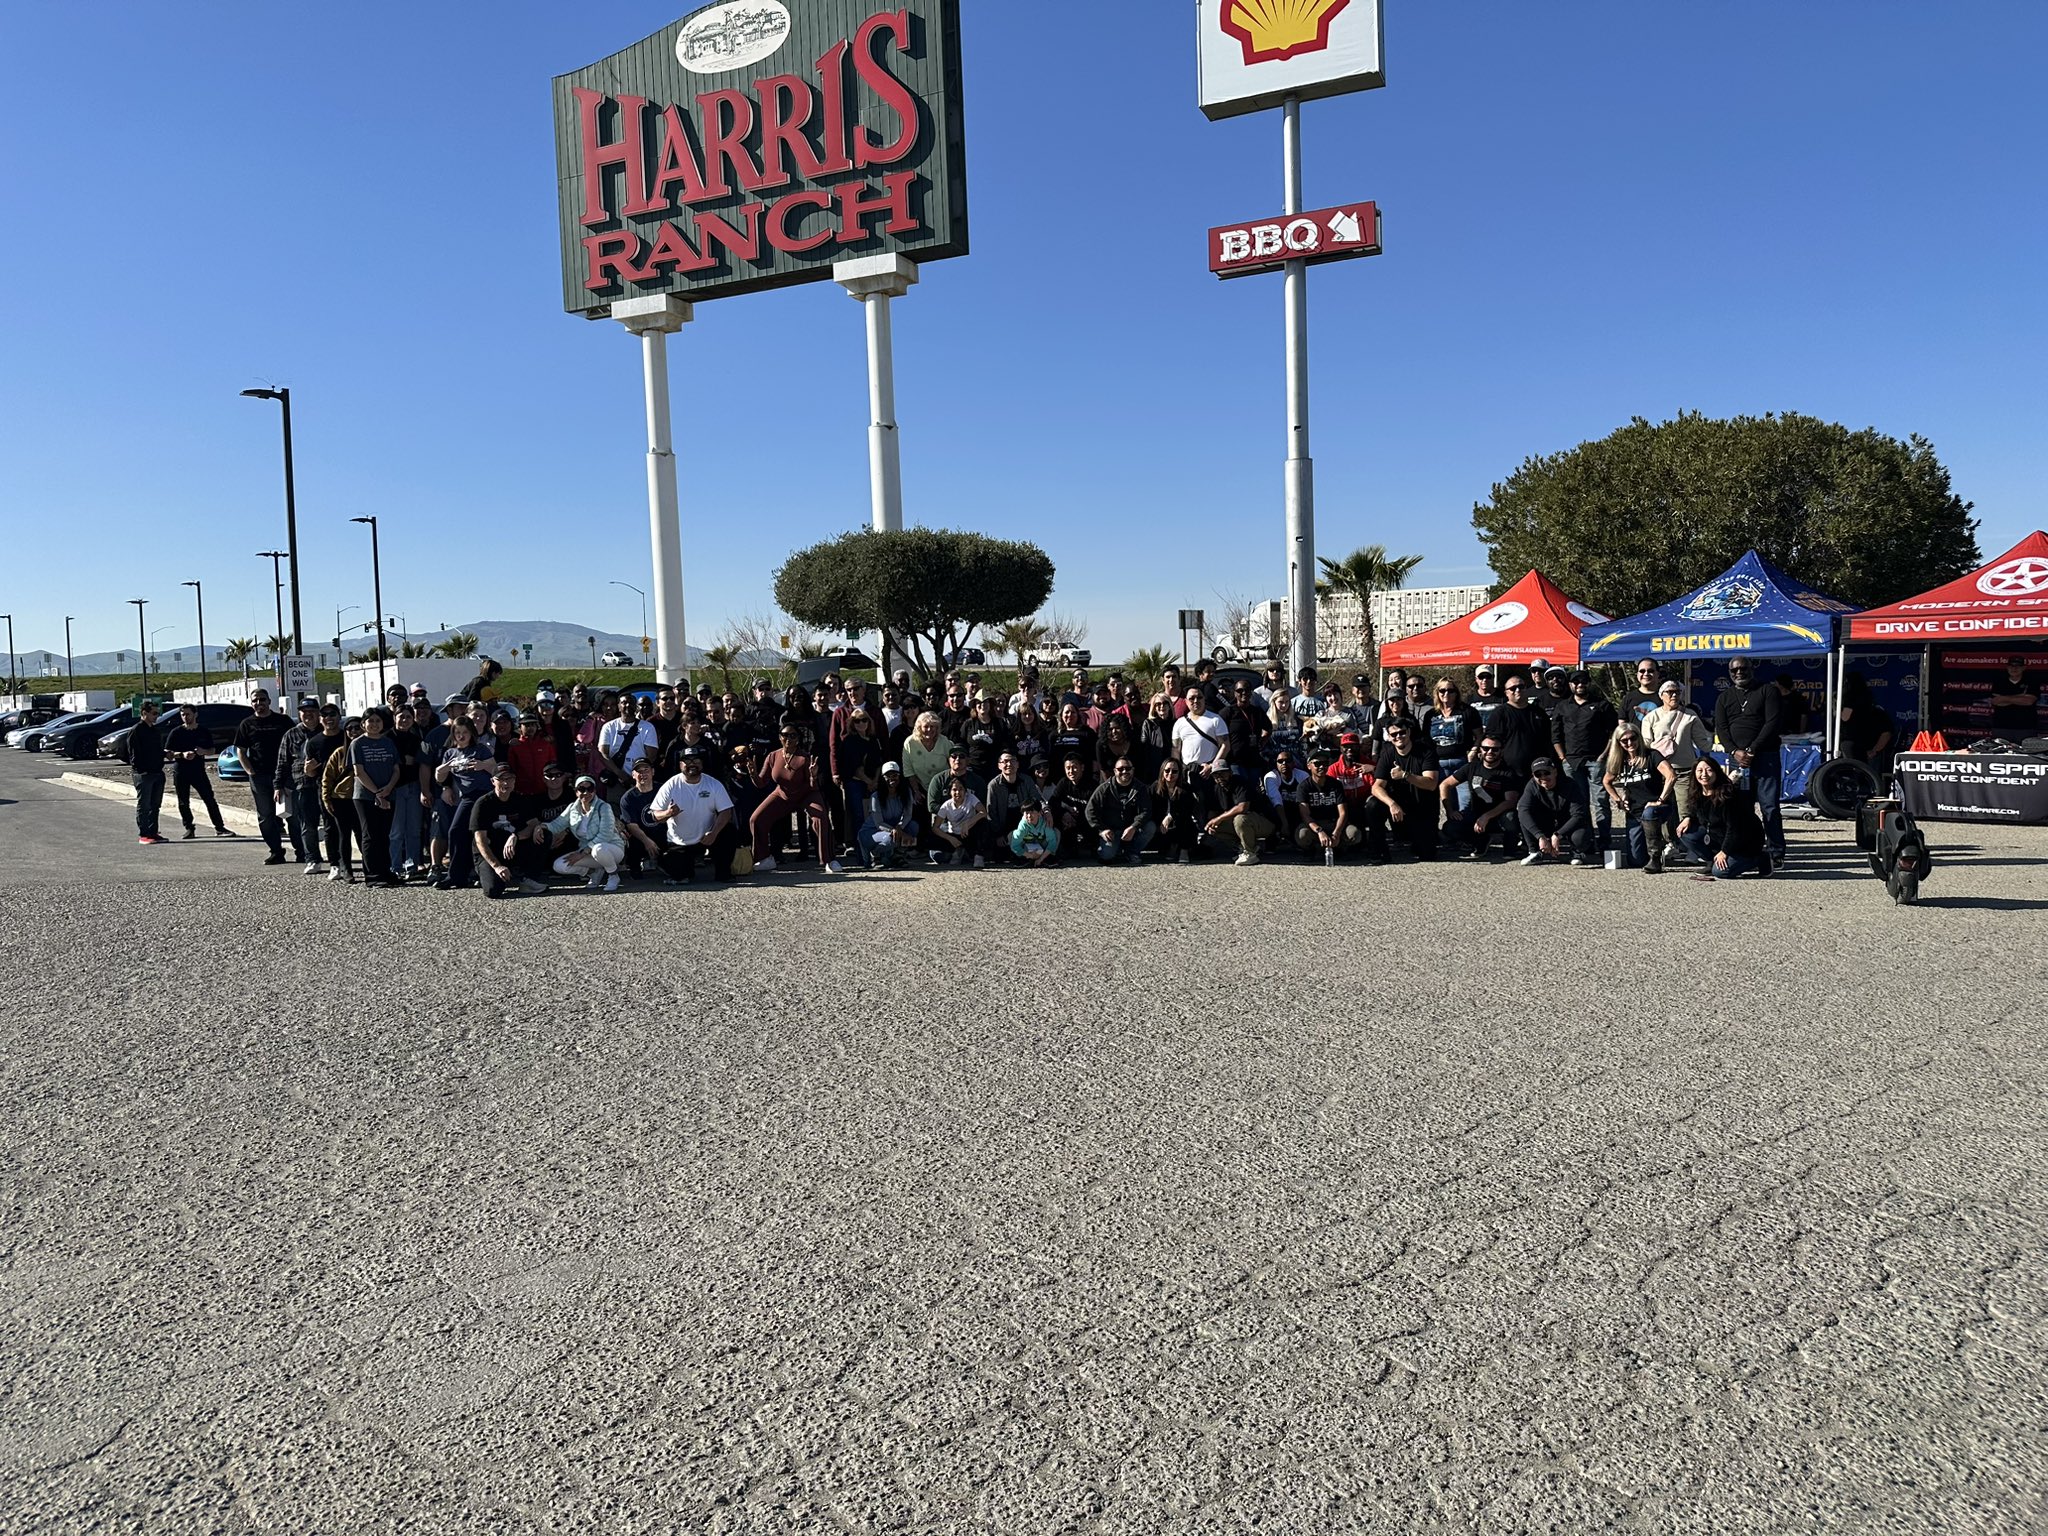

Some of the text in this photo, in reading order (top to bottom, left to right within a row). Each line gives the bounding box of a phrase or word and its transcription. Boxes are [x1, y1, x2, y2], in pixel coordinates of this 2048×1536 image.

[571, 8, 921, 227] HARRIS
[581, 169, 921, 290] RANCH
[1219, 217, 1322, 263] BBQ
[1898, 600, 2011, 611] MODERN
[1875, 621, 1940, 634] DRIVE
[1650, 633, 1751, 652] STOCKTON
[1490, 646, 1555, 654] FRESNOTESLAOWNERS
[288, 660, 312, 668] BEGIN
[291, 670, 309, 678] ONE
[291, 679, 309, 687] WAY
[1894, 760, 1982, 774] MODERN
[1917, 774, 2040, 785] DRIVE CONFIDENT
